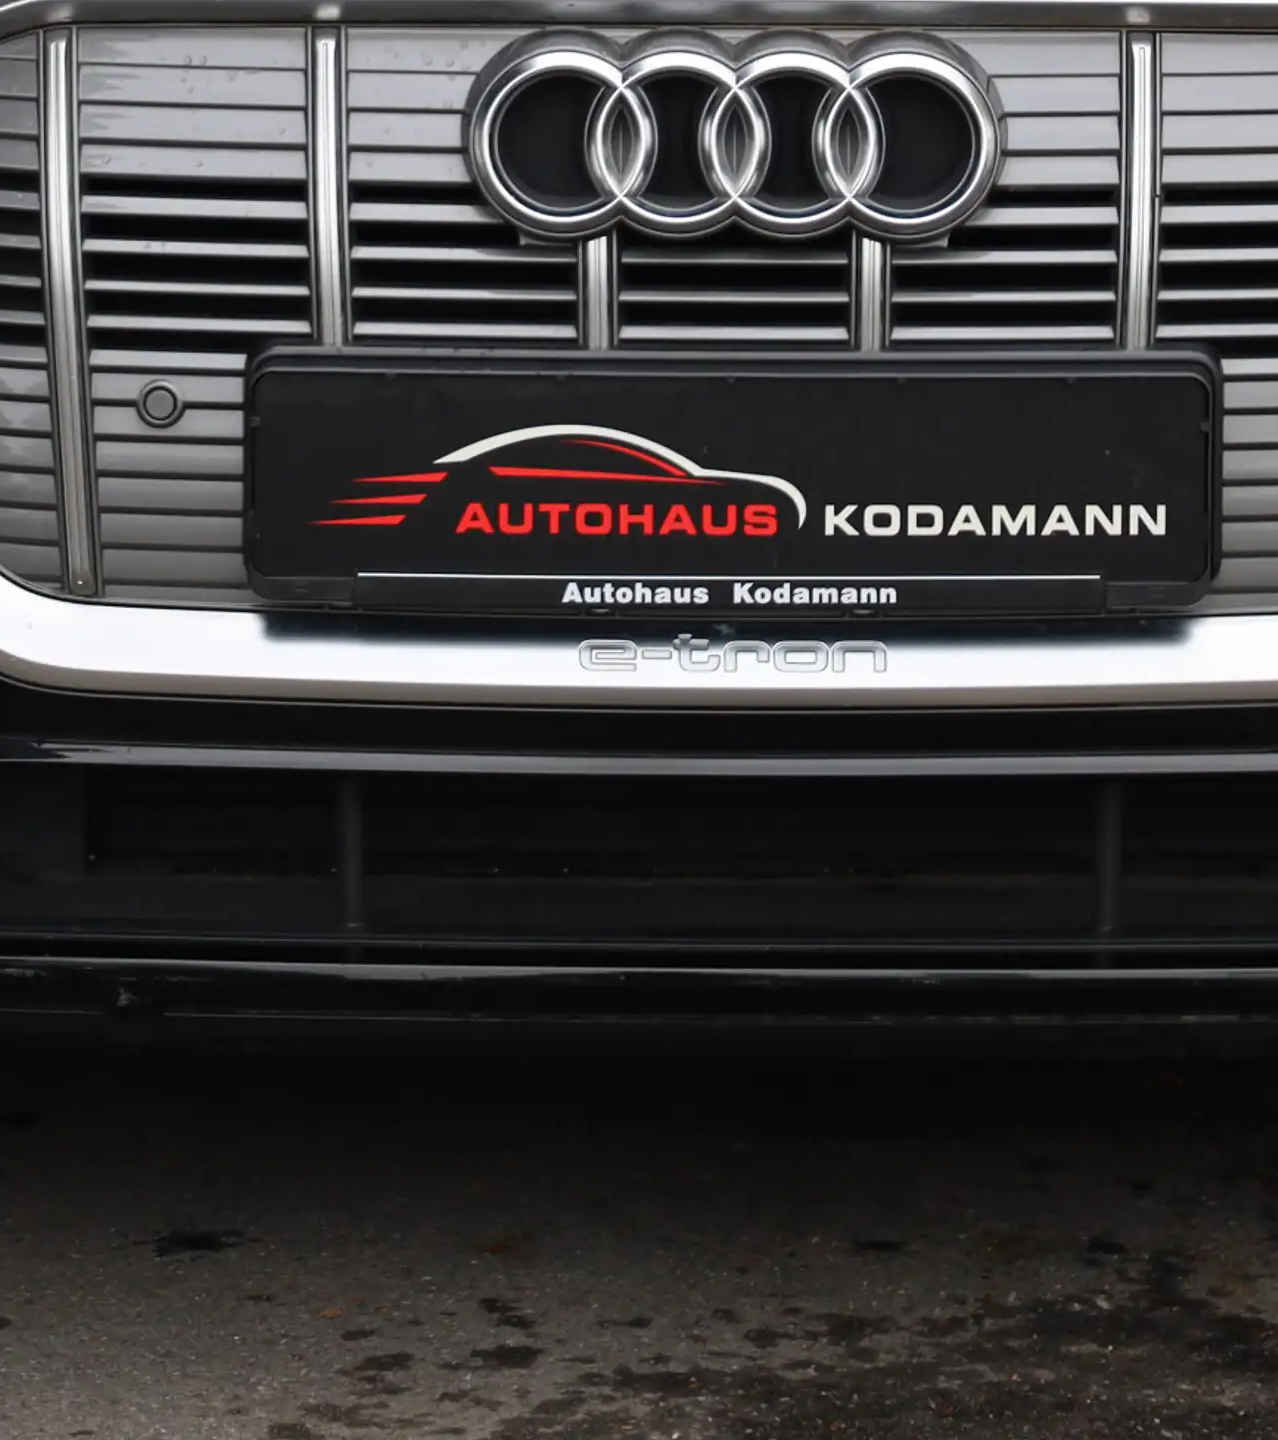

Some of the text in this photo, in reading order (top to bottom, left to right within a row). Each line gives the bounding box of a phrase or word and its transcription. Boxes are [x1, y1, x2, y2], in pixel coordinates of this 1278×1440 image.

[454, 502, 1168, 537] AUTOHAUS KODAMANN
[561, 581, 898, 605] Autohaus Kodamann
[578, 633, 888, 673] e-tron
